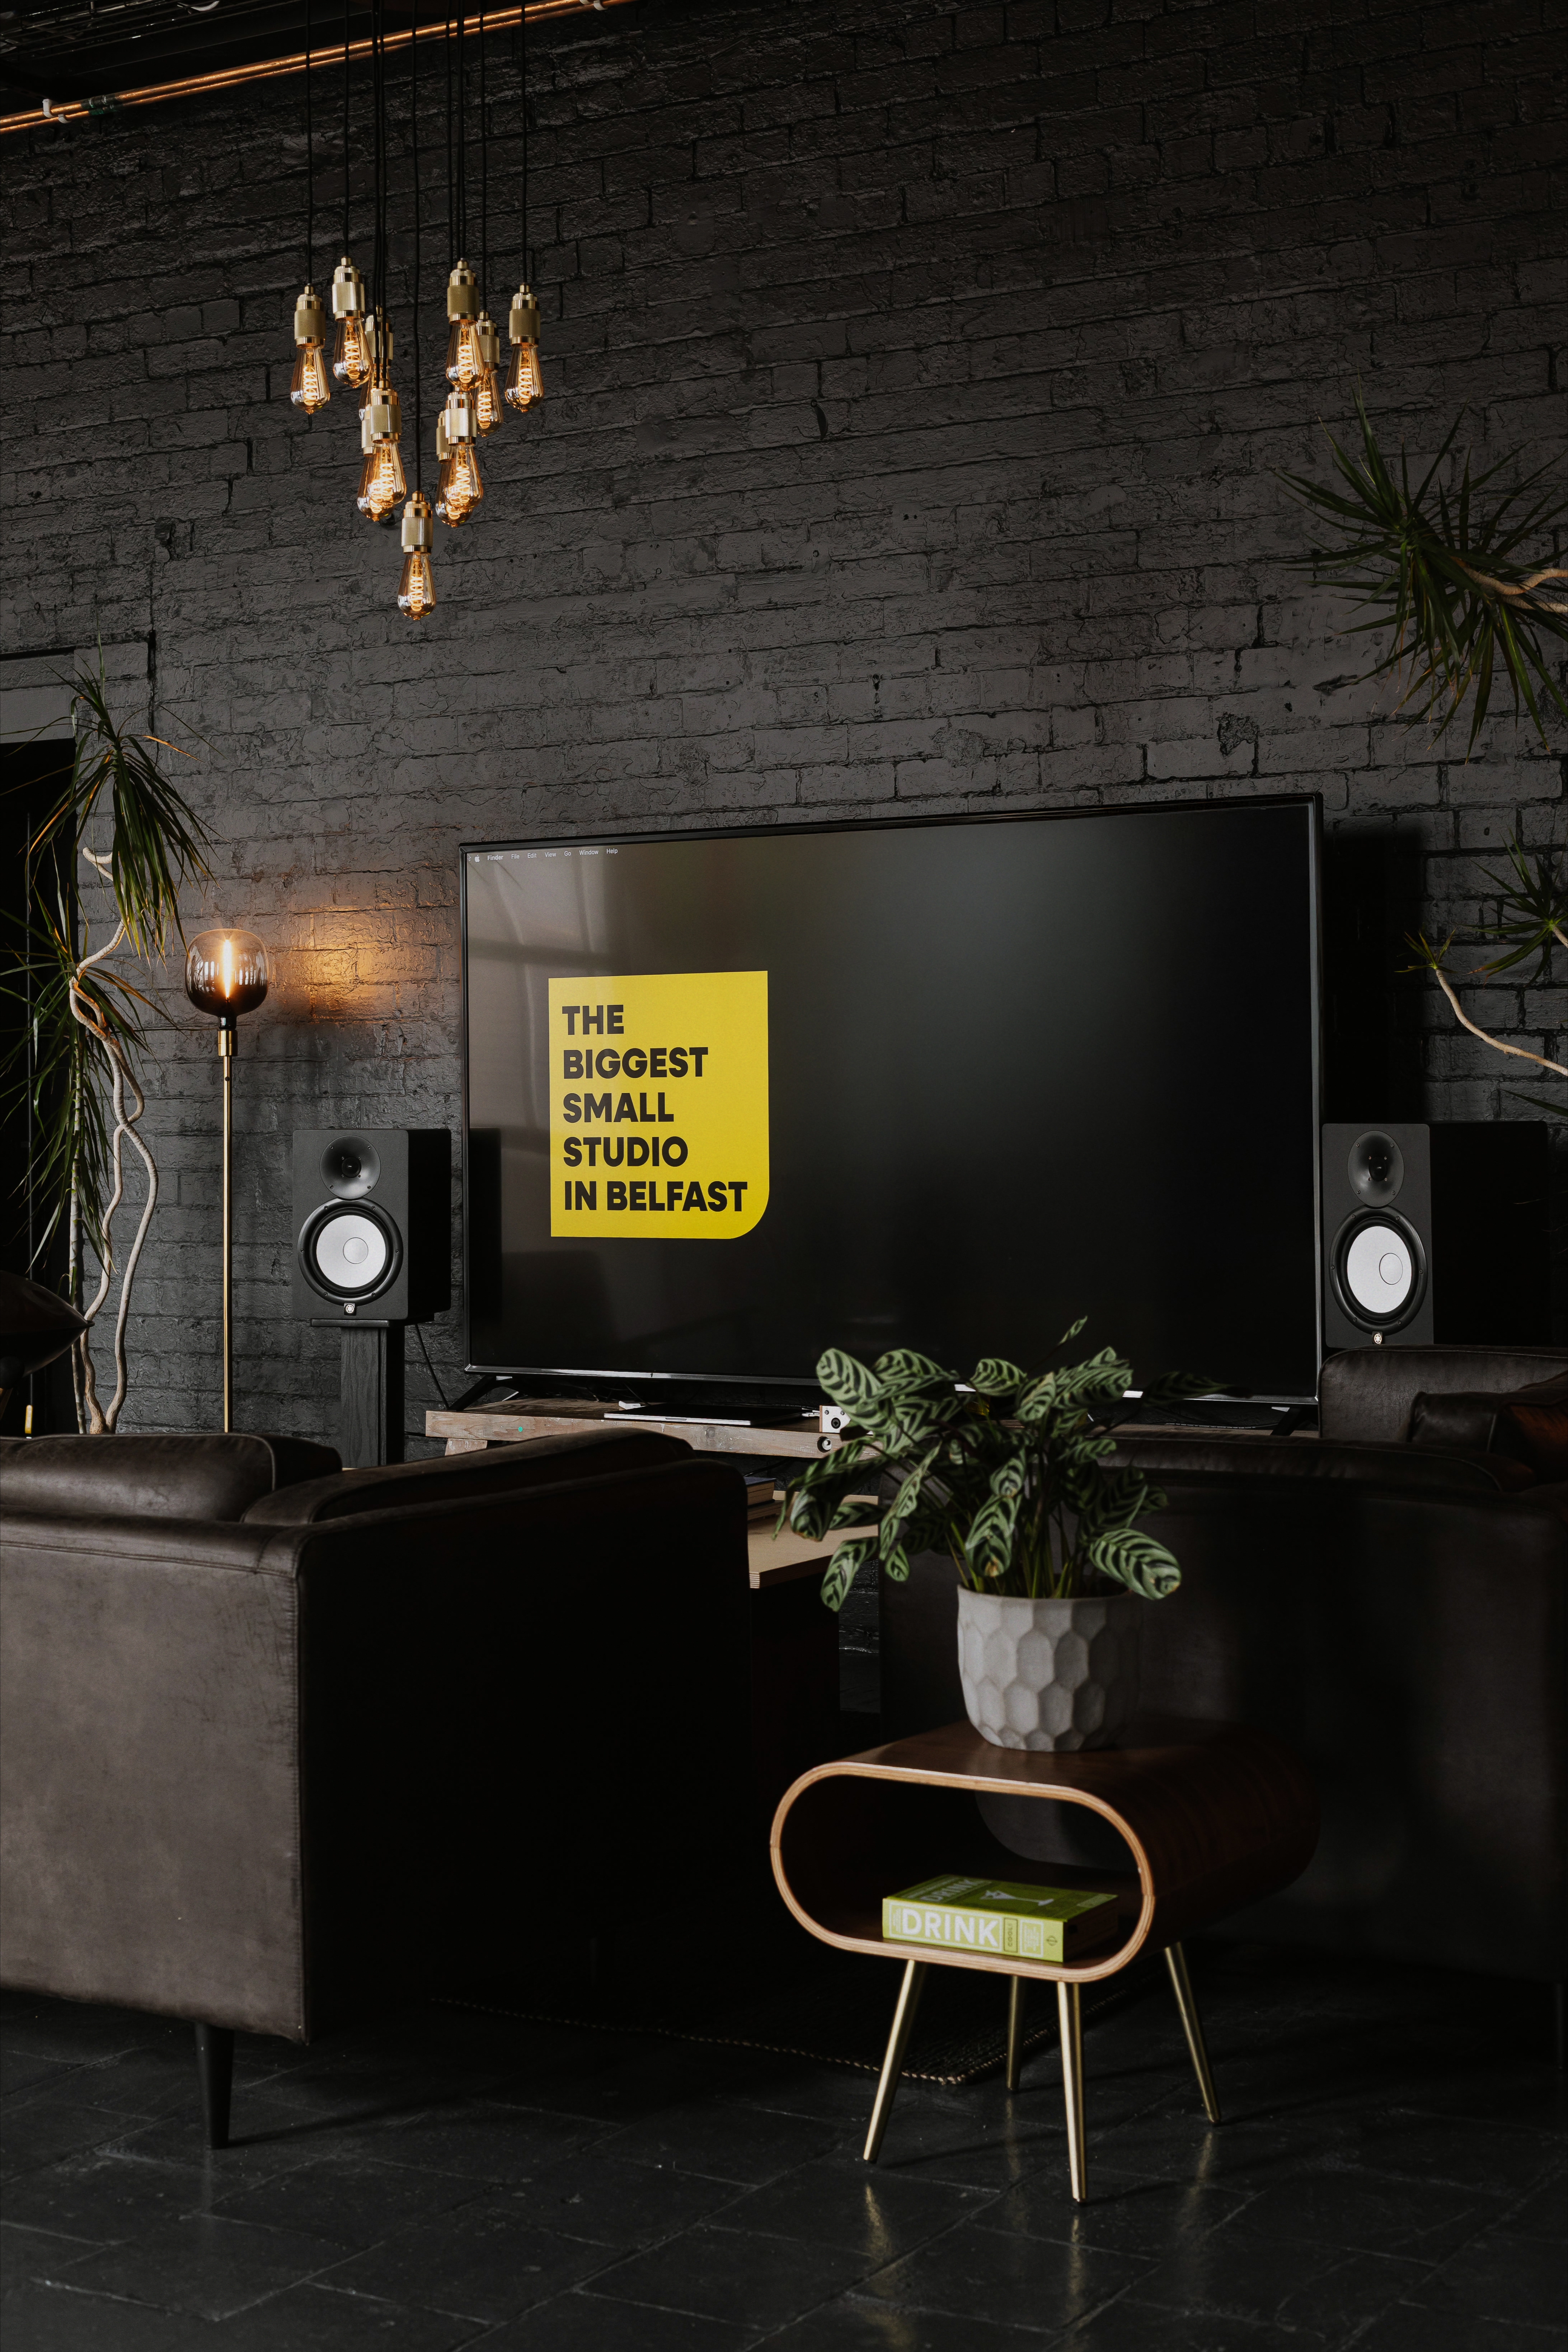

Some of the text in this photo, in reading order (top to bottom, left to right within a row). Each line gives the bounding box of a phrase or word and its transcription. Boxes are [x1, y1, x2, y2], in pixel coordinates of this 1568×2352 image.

[562, 1004, 624, 1035] THE
[563, 1047, 708, 1079] BIGGEST
[563, 1092, 674, 1123] SMALL
[563, 1136, 688, 1167] STUDIO
[564, 1181, 748, 1212] IN BELFAST
[902, 1908, 999, 1947] DRINK
